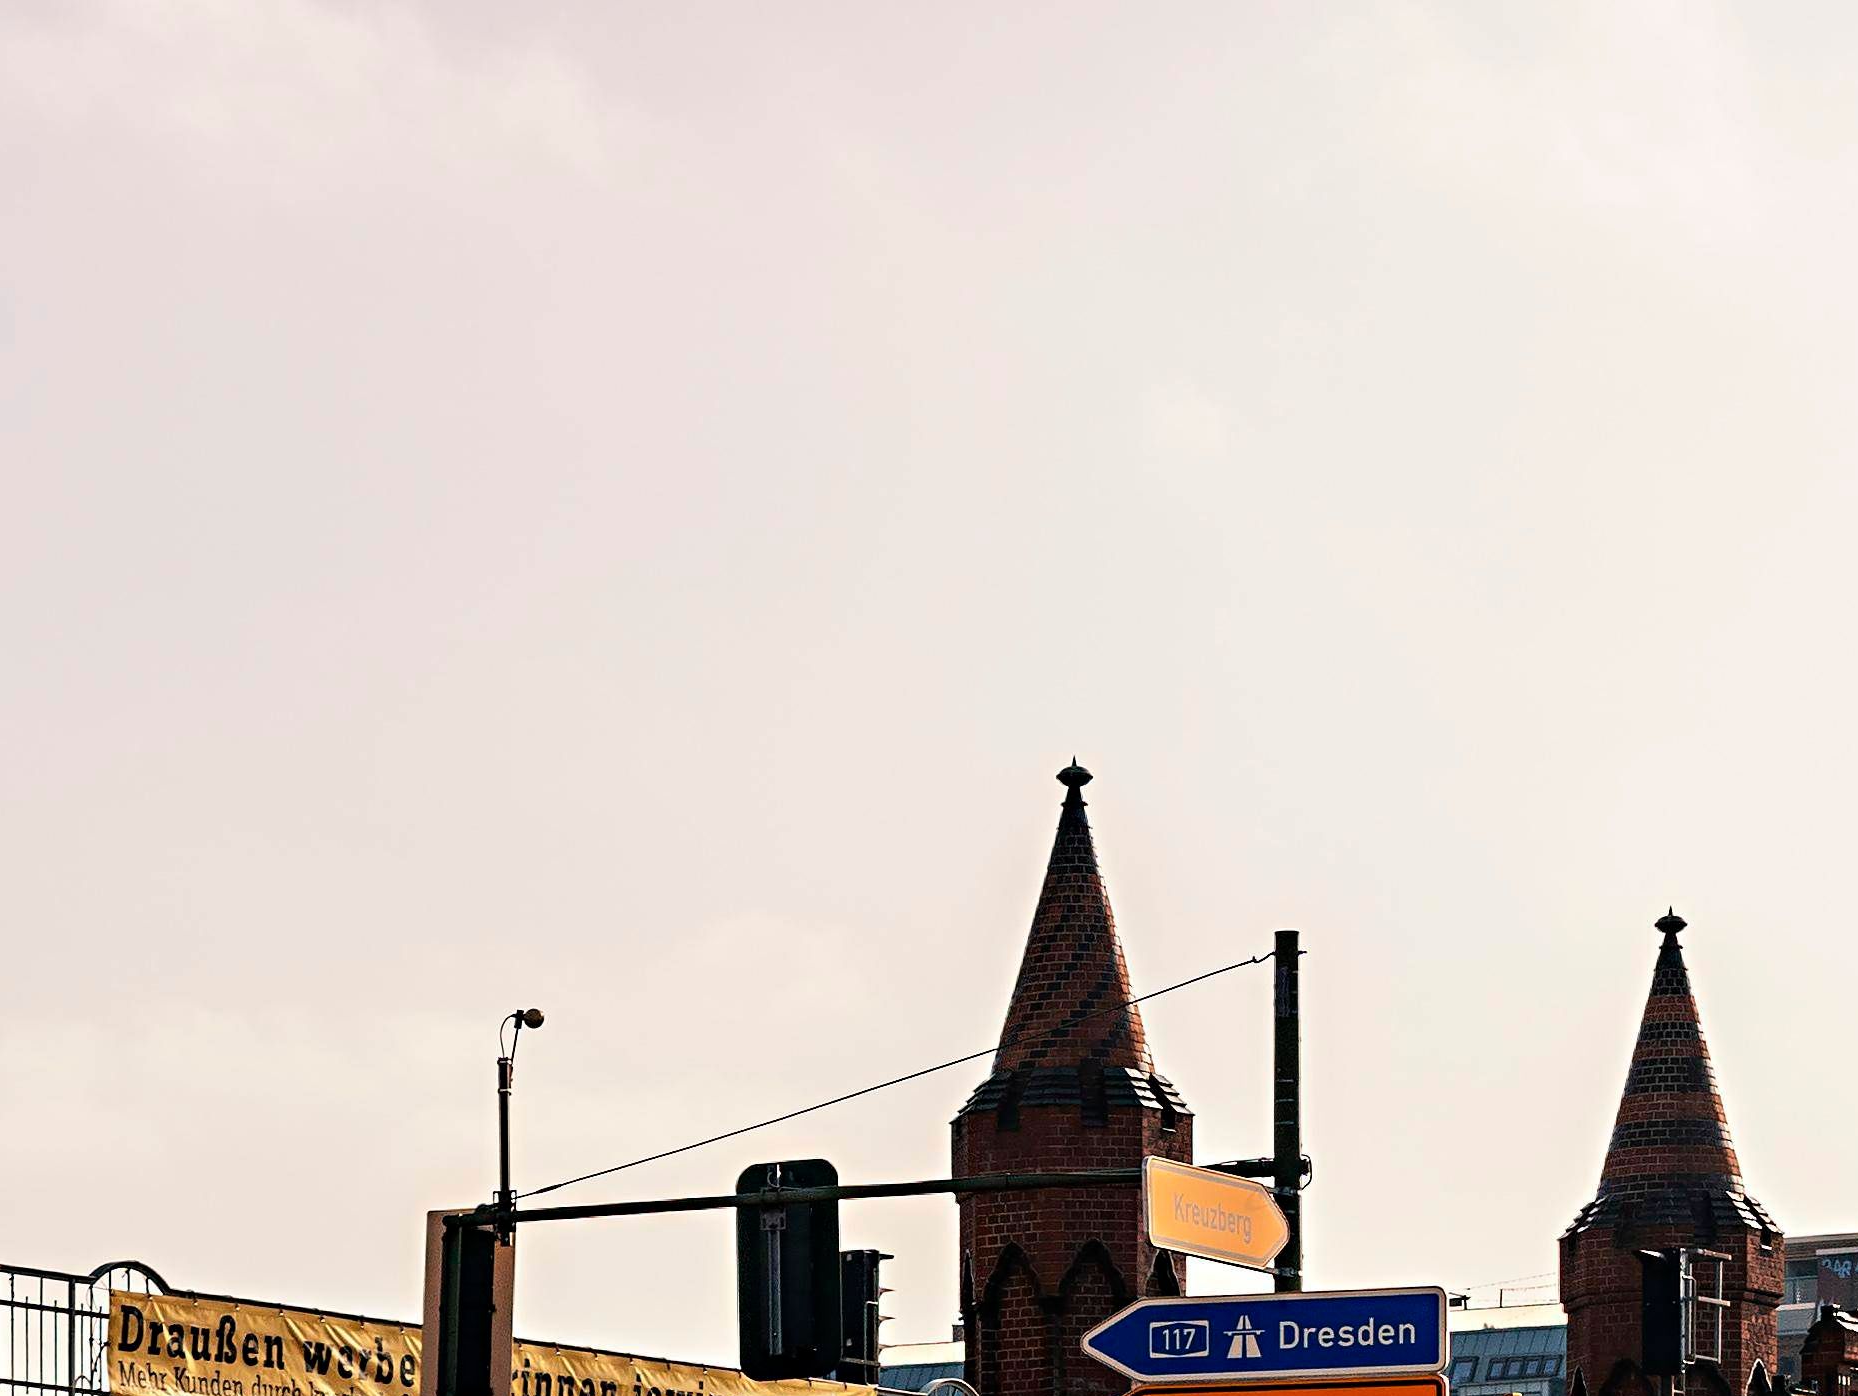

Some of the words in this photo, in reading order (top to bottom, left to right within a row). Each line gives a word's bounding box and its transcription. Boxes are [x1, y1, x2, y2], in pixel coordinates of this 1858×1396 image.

[1174, 1192, 1252, 1244] Kreuzberg
[118, 1304, 285, 1371] Draußen
[1162, 1328, 1196, 1351] 117
[1279, 1316, 1416, 1350] Dresden
[117, 1360, 167, 1391] Mehr
